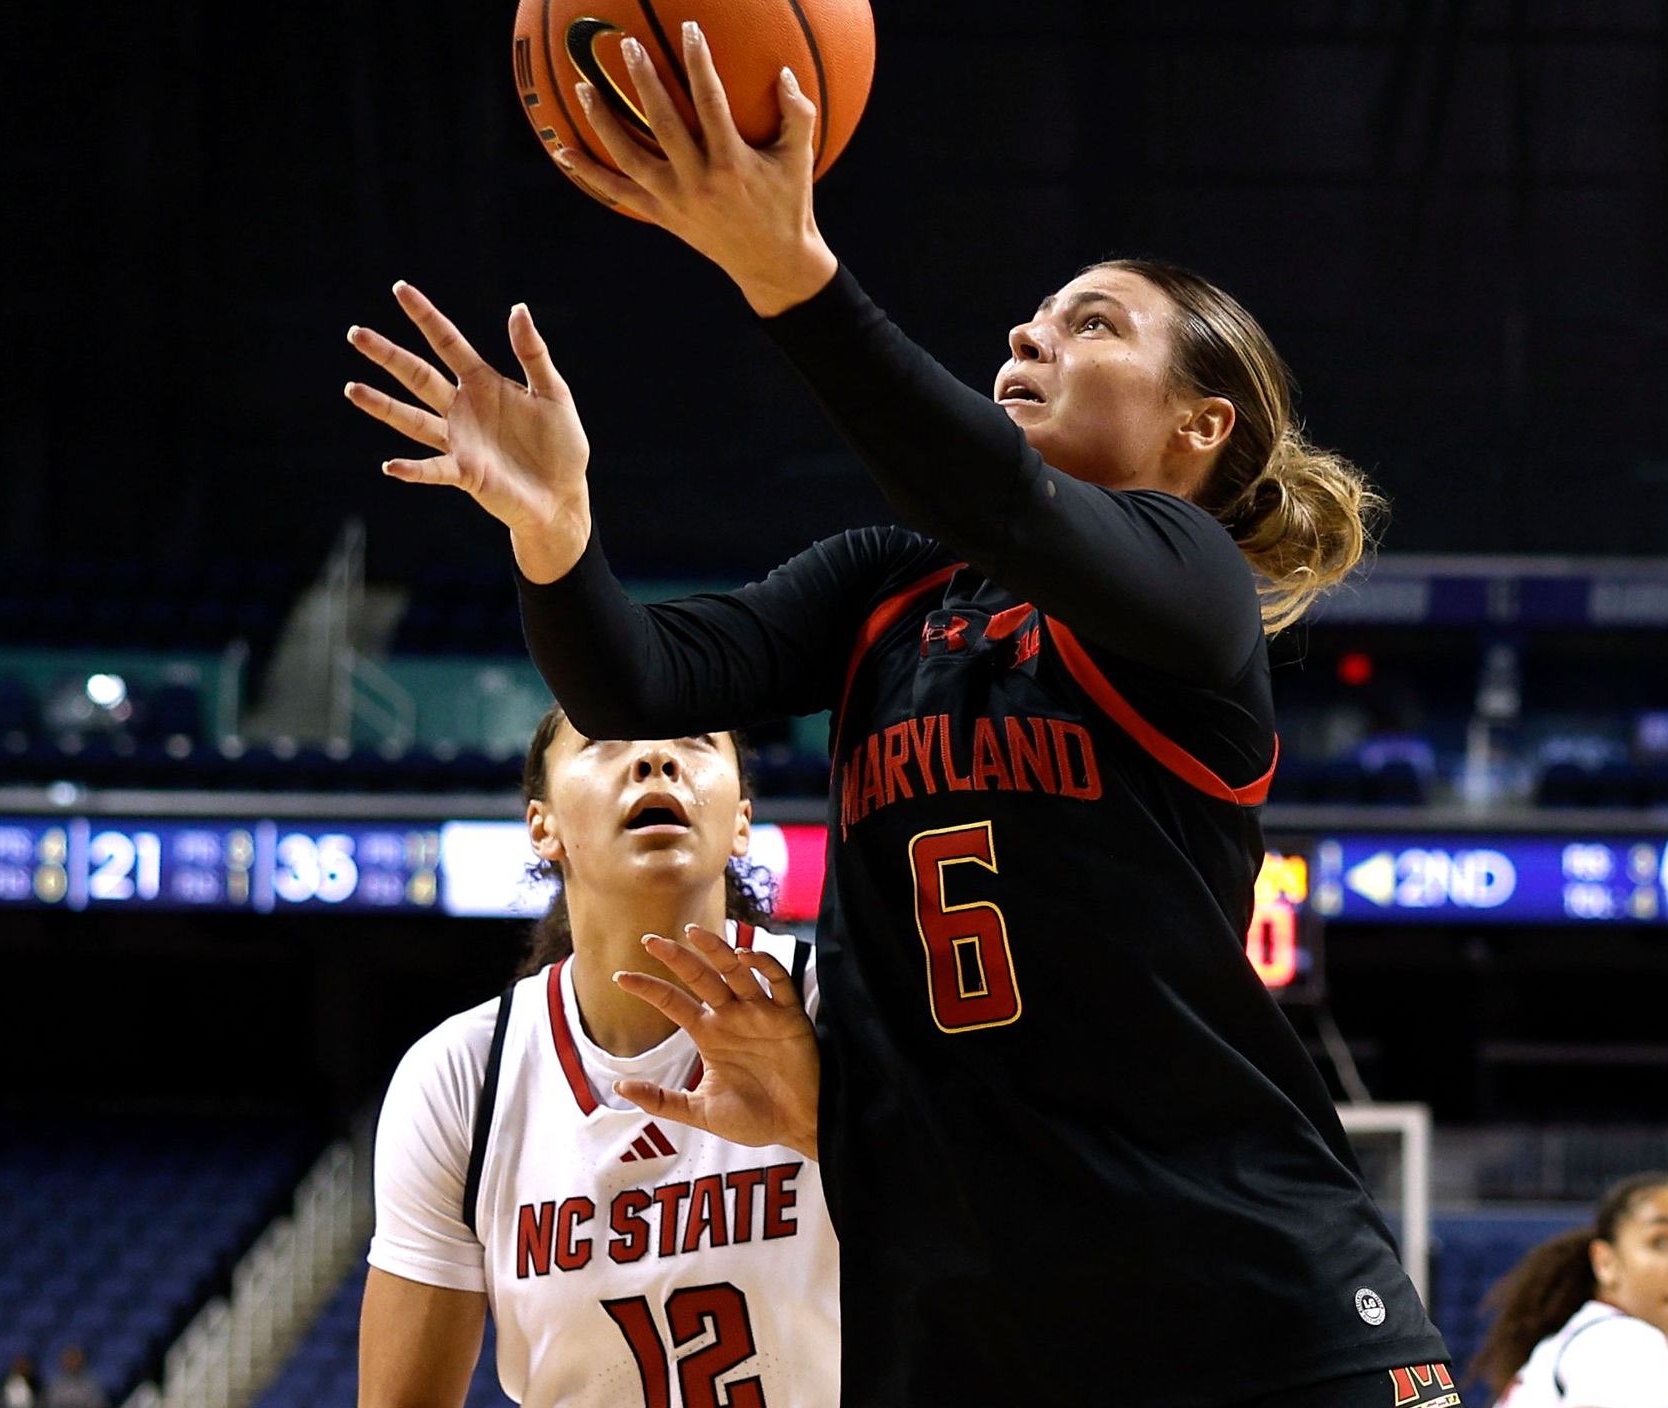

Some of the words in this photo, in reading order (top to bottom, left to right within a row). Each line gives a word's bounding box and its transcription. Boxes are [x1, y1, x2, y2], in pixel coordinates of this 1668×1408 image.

[840, 714, 1104, 843] MARYLAND
[89, 830, 162, 902] 21
[1393, 848, 1518, 909] 2ND
[908, 820, 1023, 1034] 6
[516, 1195, 596, 1280] NC
[607, 1160, 804, 1264] STATE
